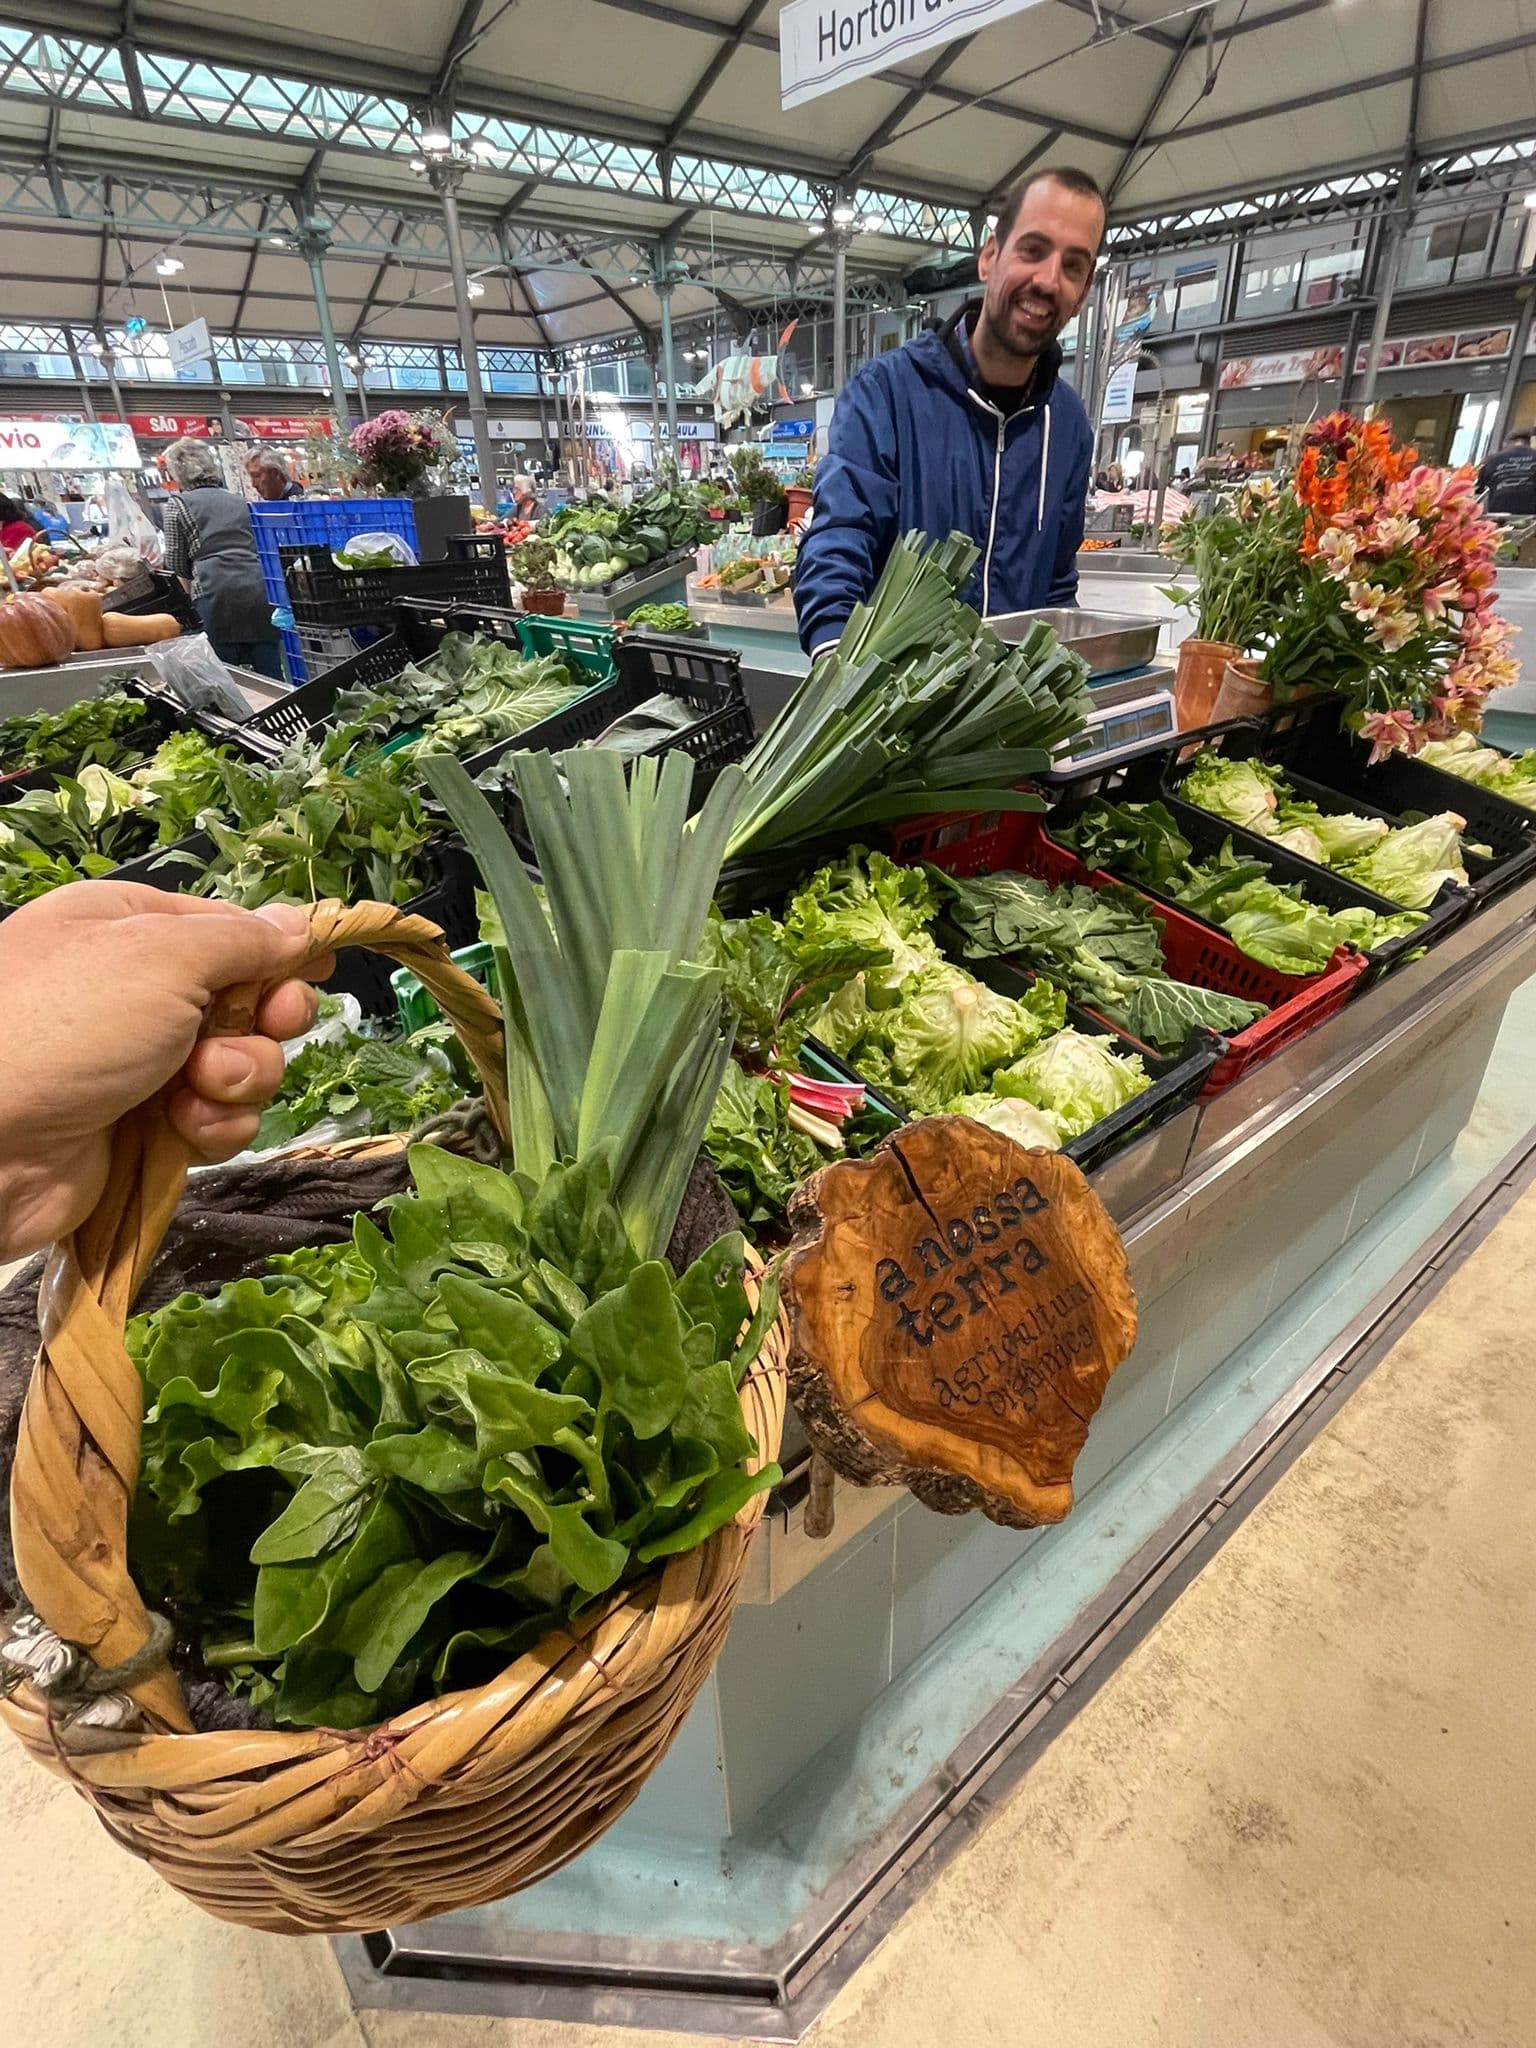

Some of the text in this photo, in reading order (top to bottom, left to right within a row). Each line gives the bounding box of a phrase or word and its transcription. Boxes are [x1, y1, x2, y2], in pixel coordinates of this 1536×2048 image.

[149, 416, 178, 432] SÃO
[875, 1177, 1048, 1301] a nossa
[896, 1238, 1048, 1347] terra
[932, 1281, 1092, 1407] agricultura
